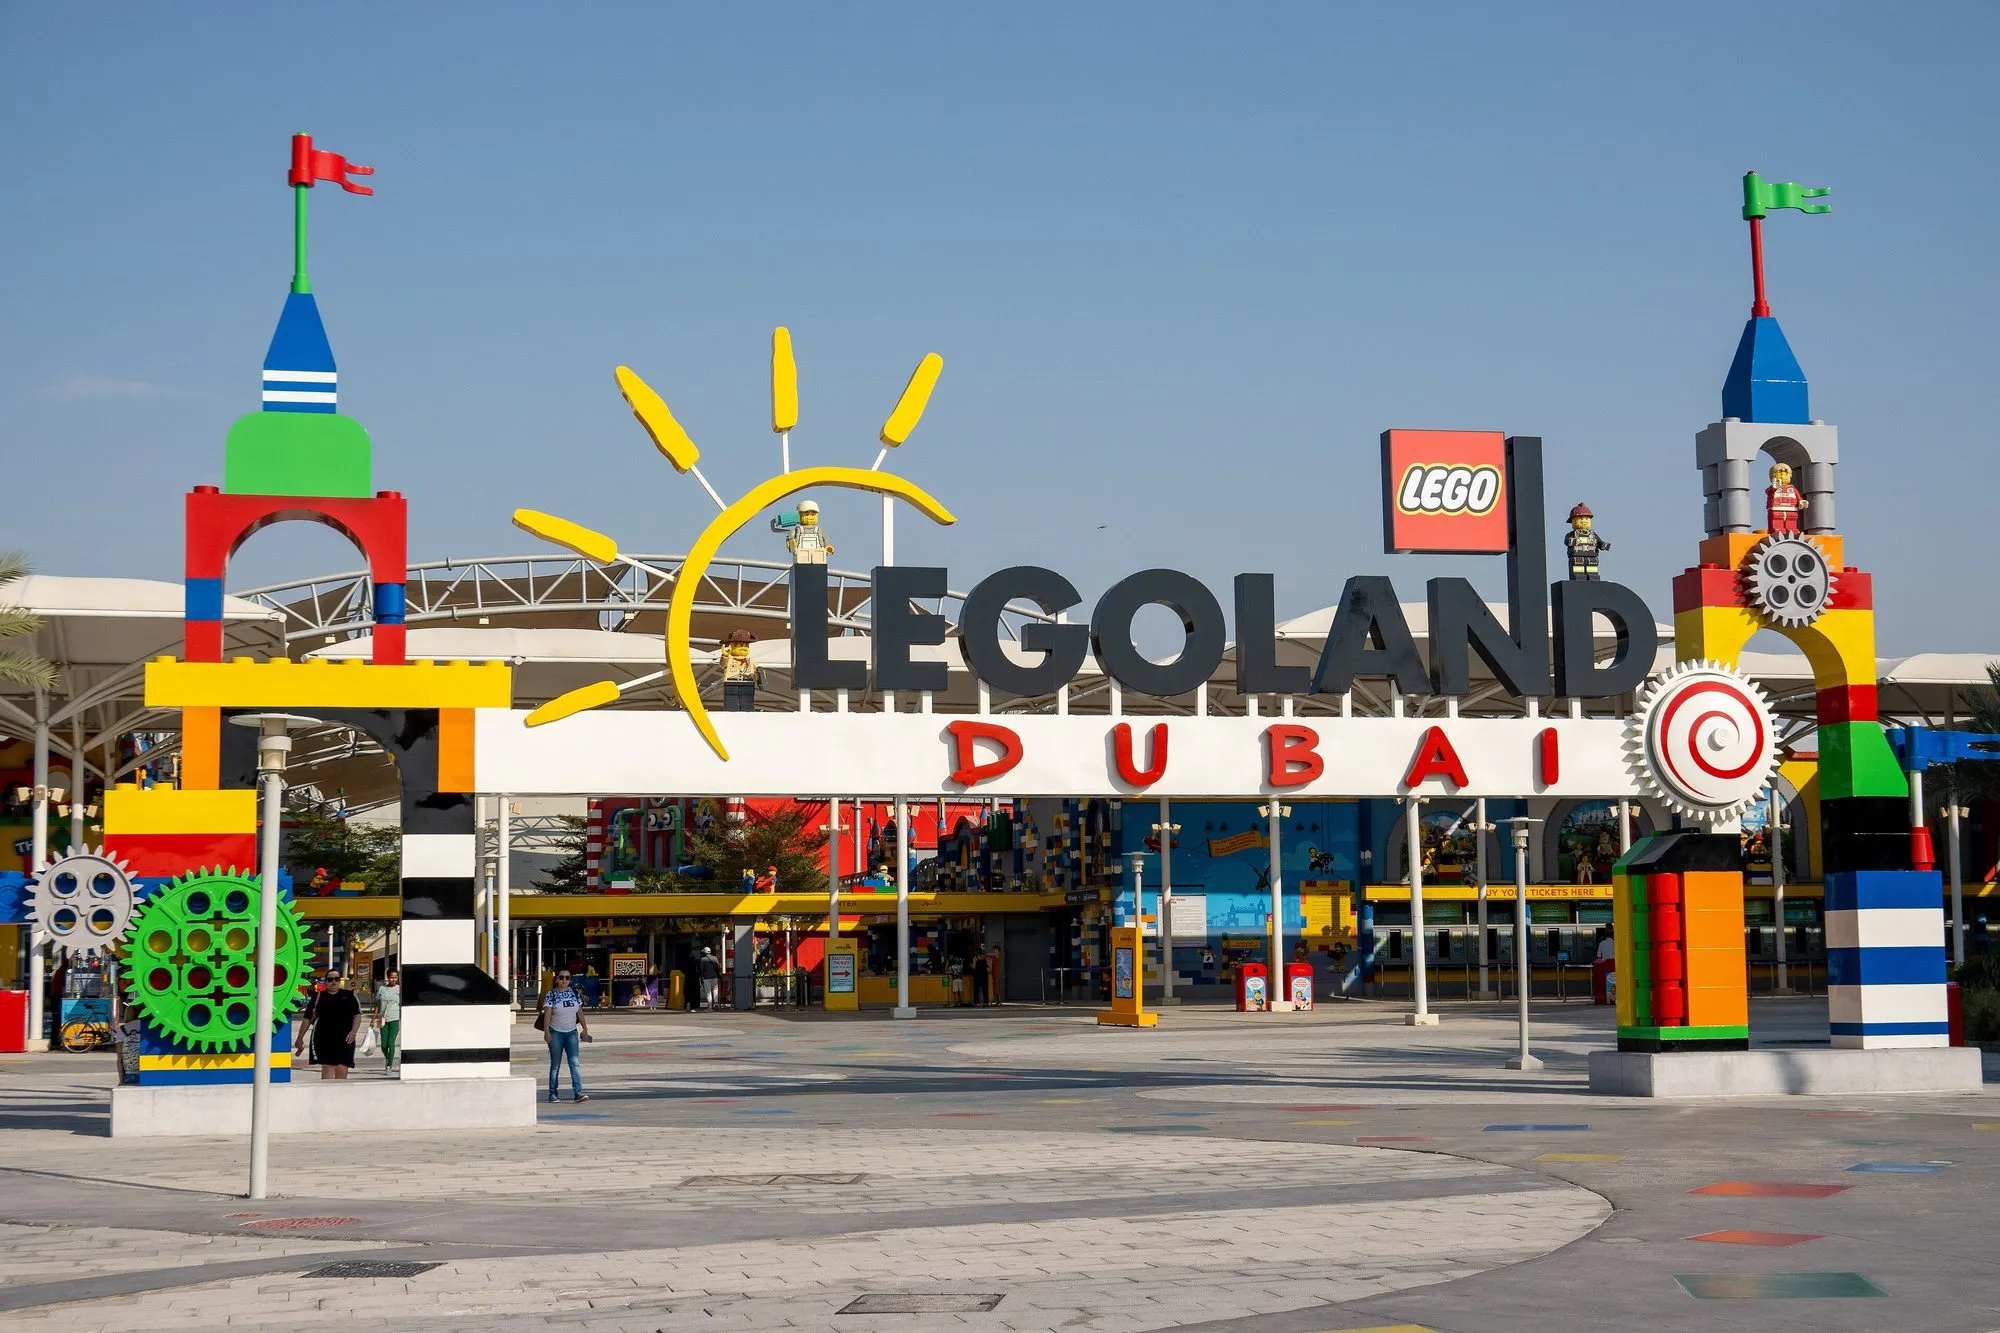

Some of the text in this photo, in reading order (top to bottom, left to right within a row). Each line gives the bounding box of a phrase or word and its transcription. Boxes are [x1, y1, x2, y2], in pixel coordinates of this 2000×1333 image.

[1402, 468, 1497, 511] LEGO
[790, 437, 1657, 698] LEGOLAND
[947, 720, 1559, 788] DUBAI
[1487, 889, 1498, 897] UY
[1530, 888, 1568, 896] TICKETS
[1571, 888, 1594, 896] HERE
